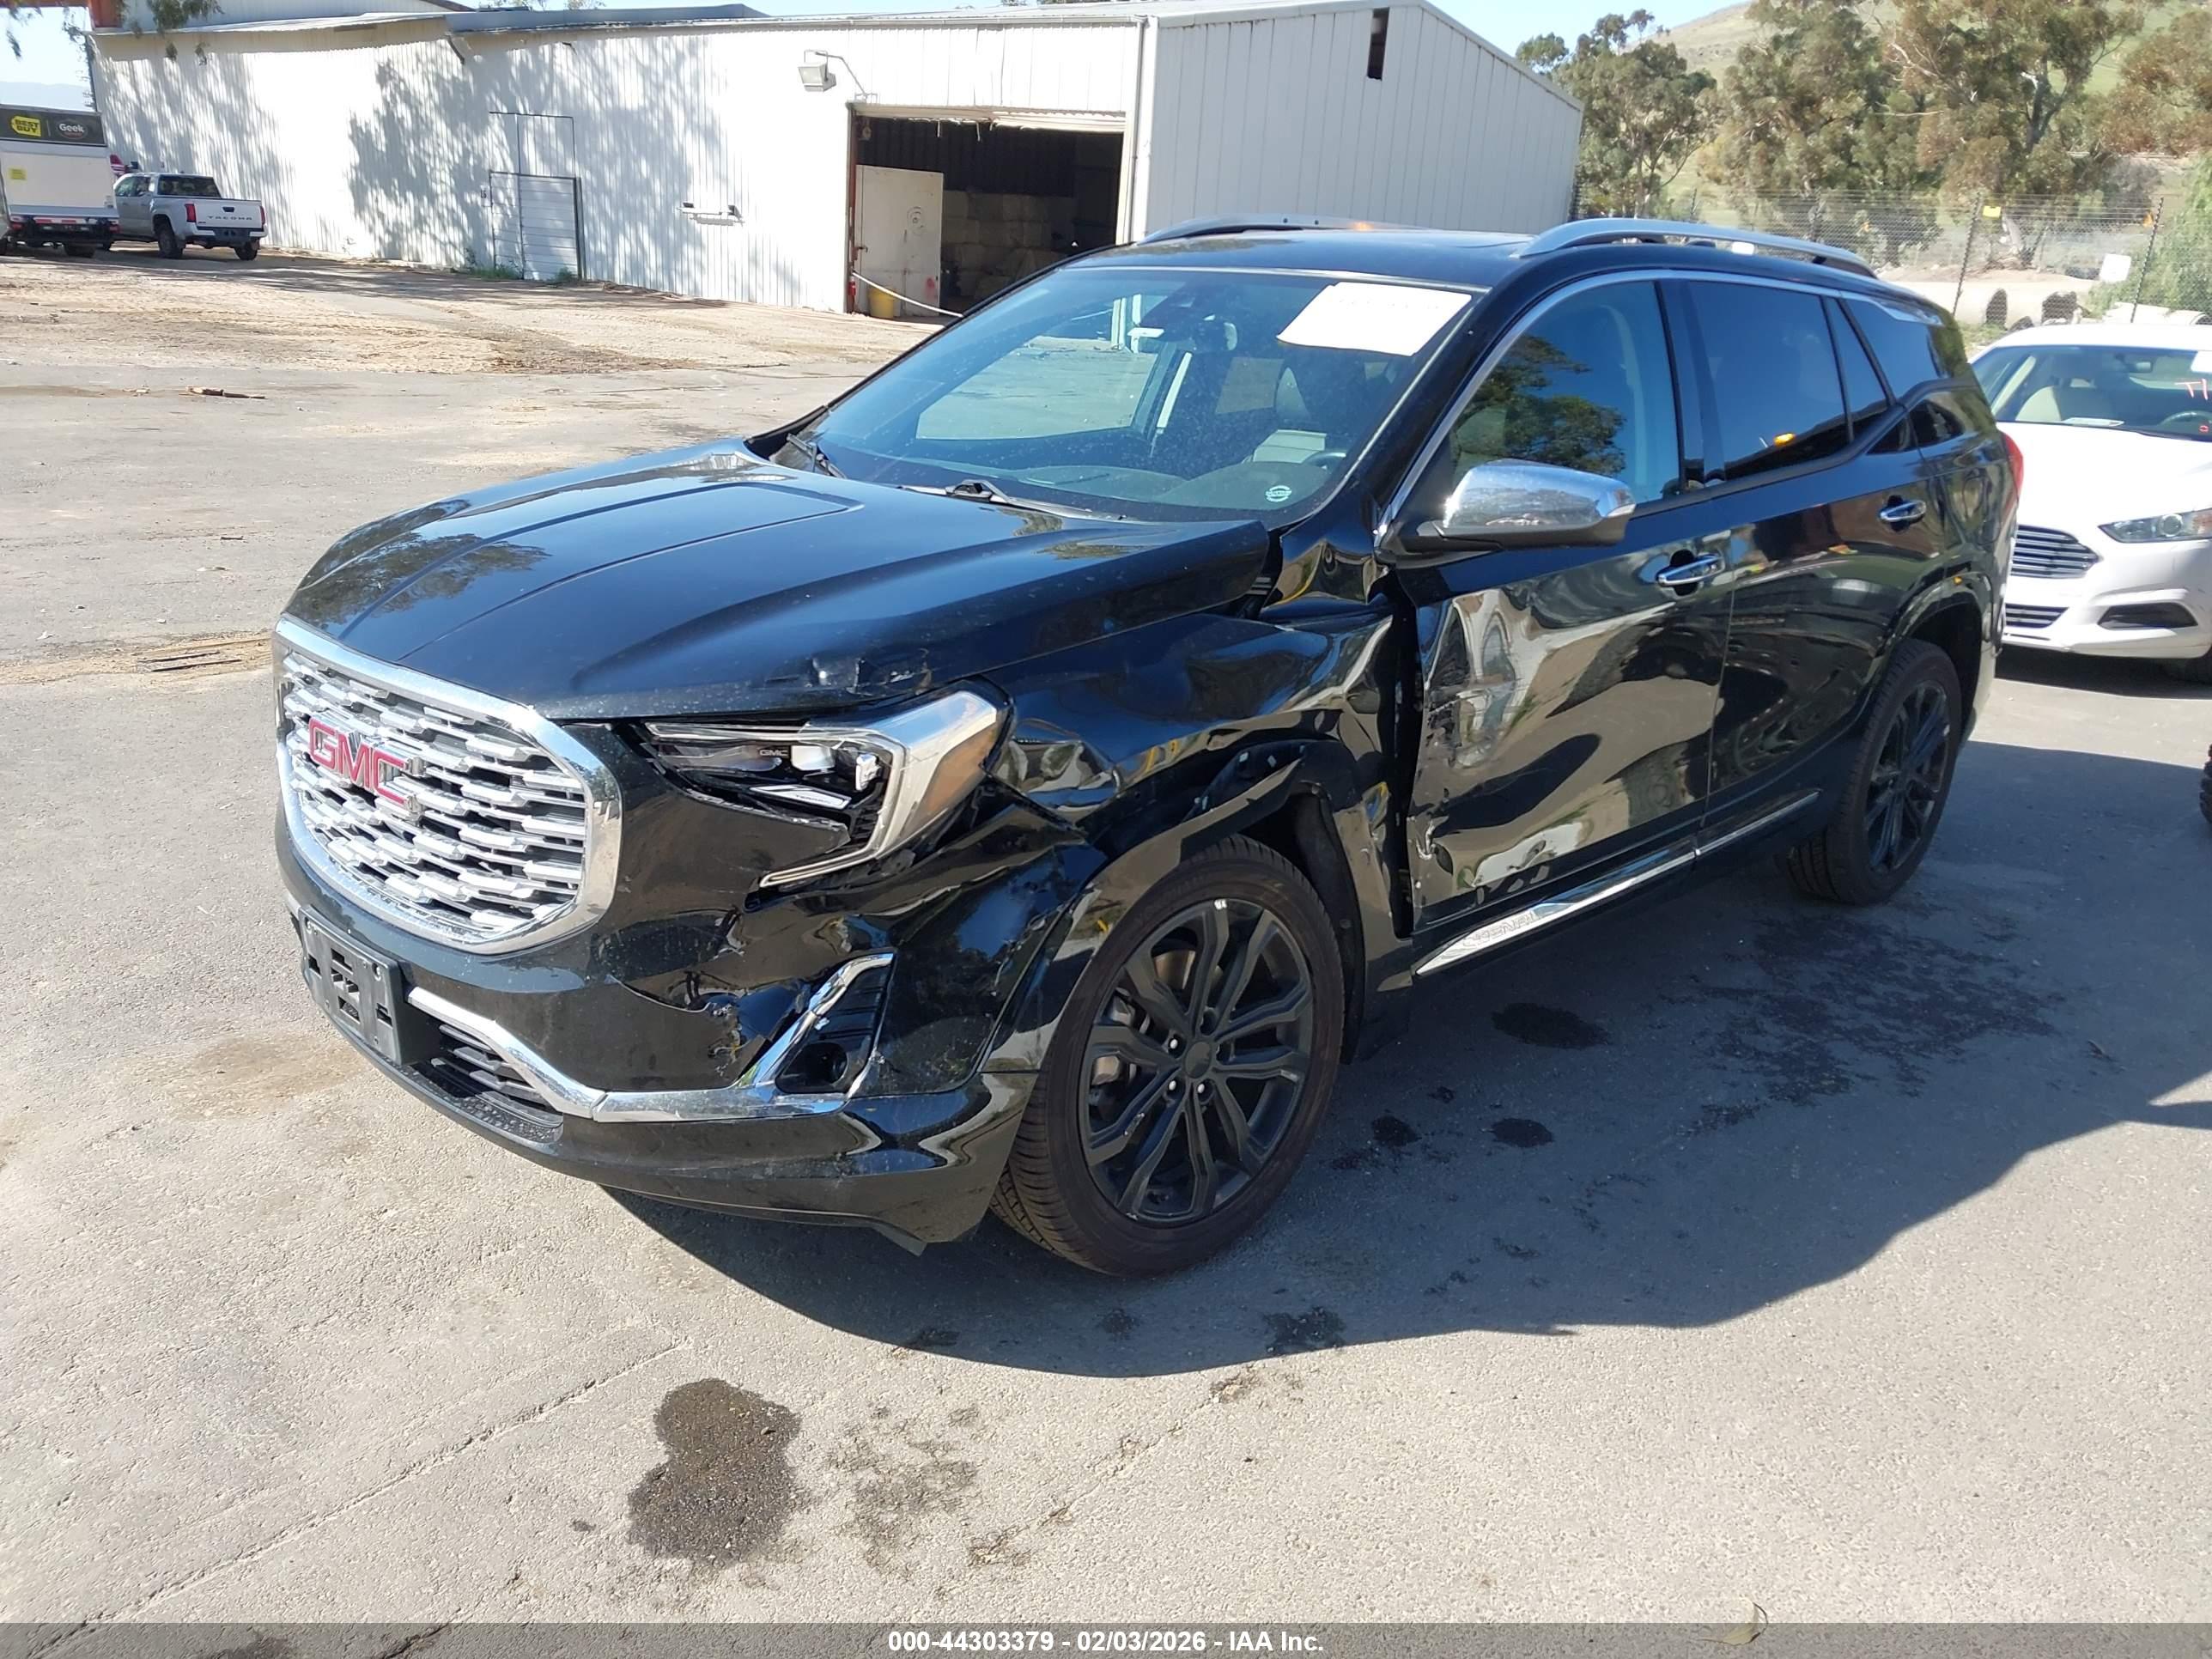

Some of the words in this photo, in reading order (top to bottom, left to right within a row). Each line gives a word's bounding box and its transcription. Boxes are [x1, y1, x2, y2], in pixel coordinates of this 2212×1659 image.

[15, 118, 39, 128] BEST
[58, 123, 85, 133] Geek
[308, 717, 408, 807] GMC
